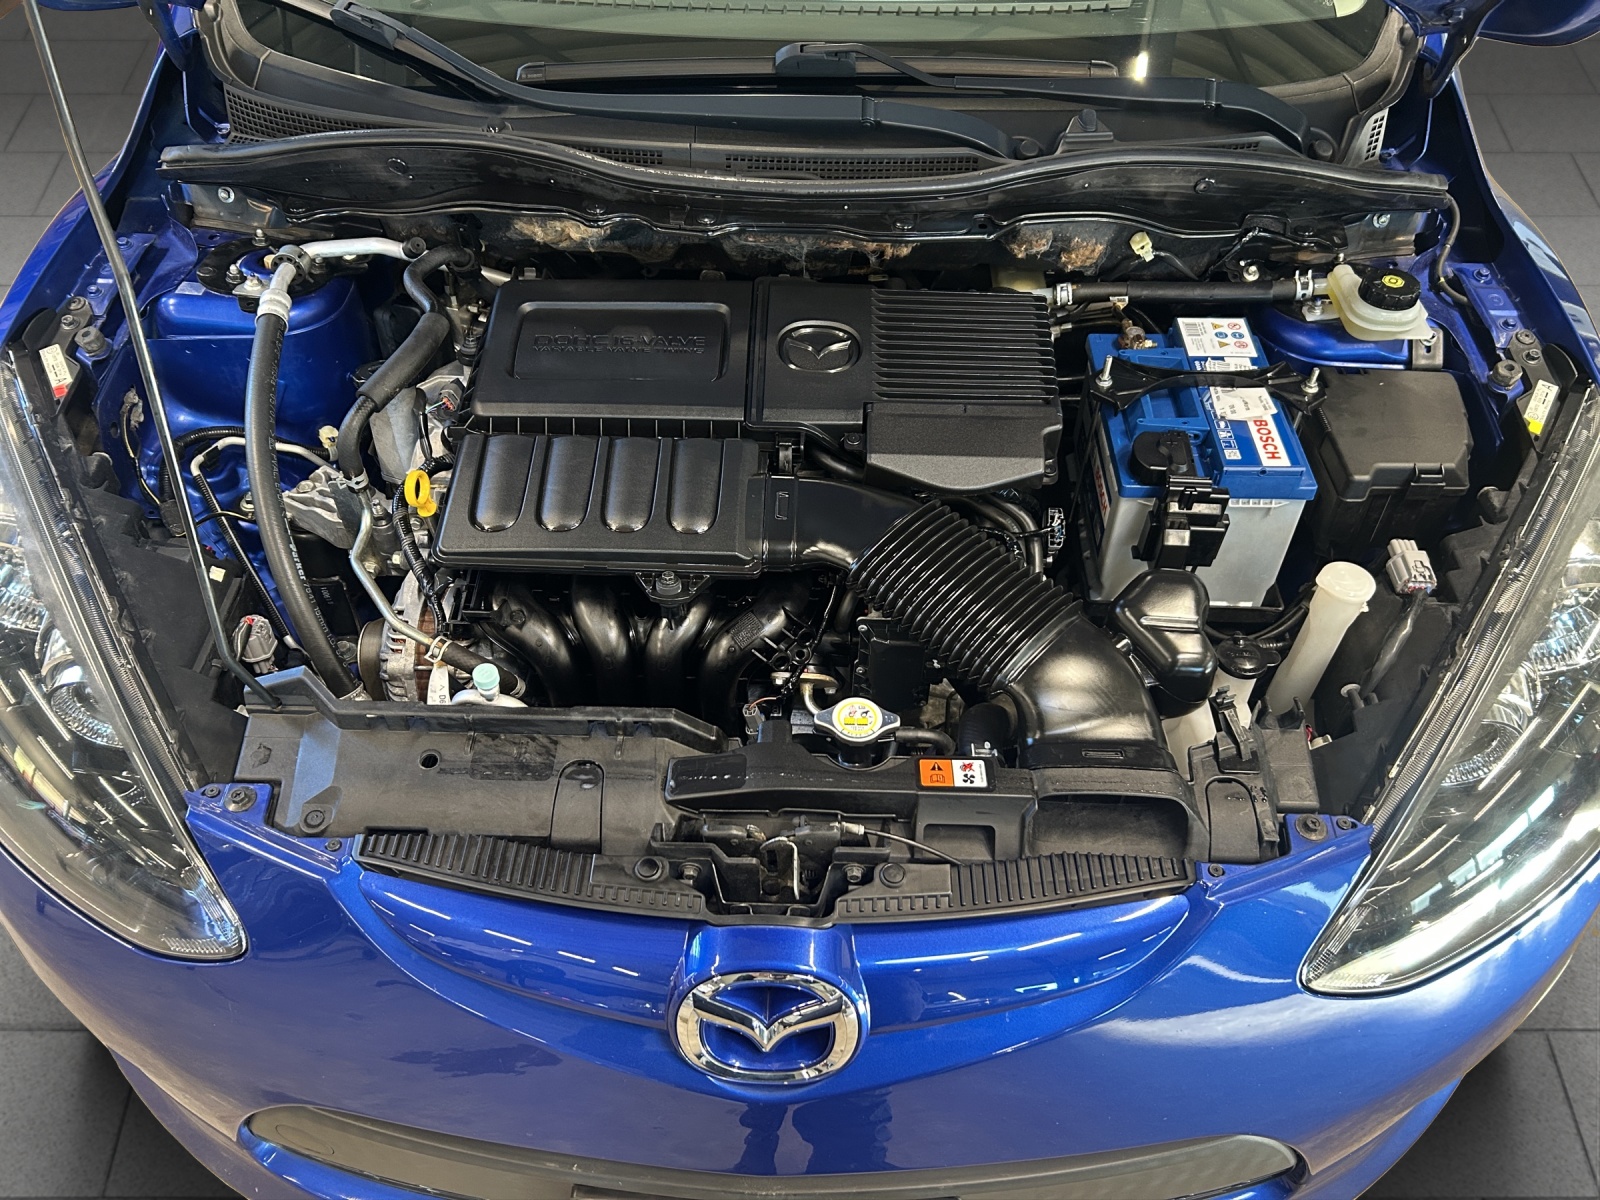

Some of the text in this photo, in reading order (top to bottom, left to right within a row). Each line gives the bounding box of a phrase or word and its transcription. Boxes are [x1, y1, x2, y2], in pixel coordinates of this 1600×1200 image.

[533, 335, 609, 346] DOHC
[1253, 419, 1282, 460] BOSCH
[289, 543, 306, 581] Parker
